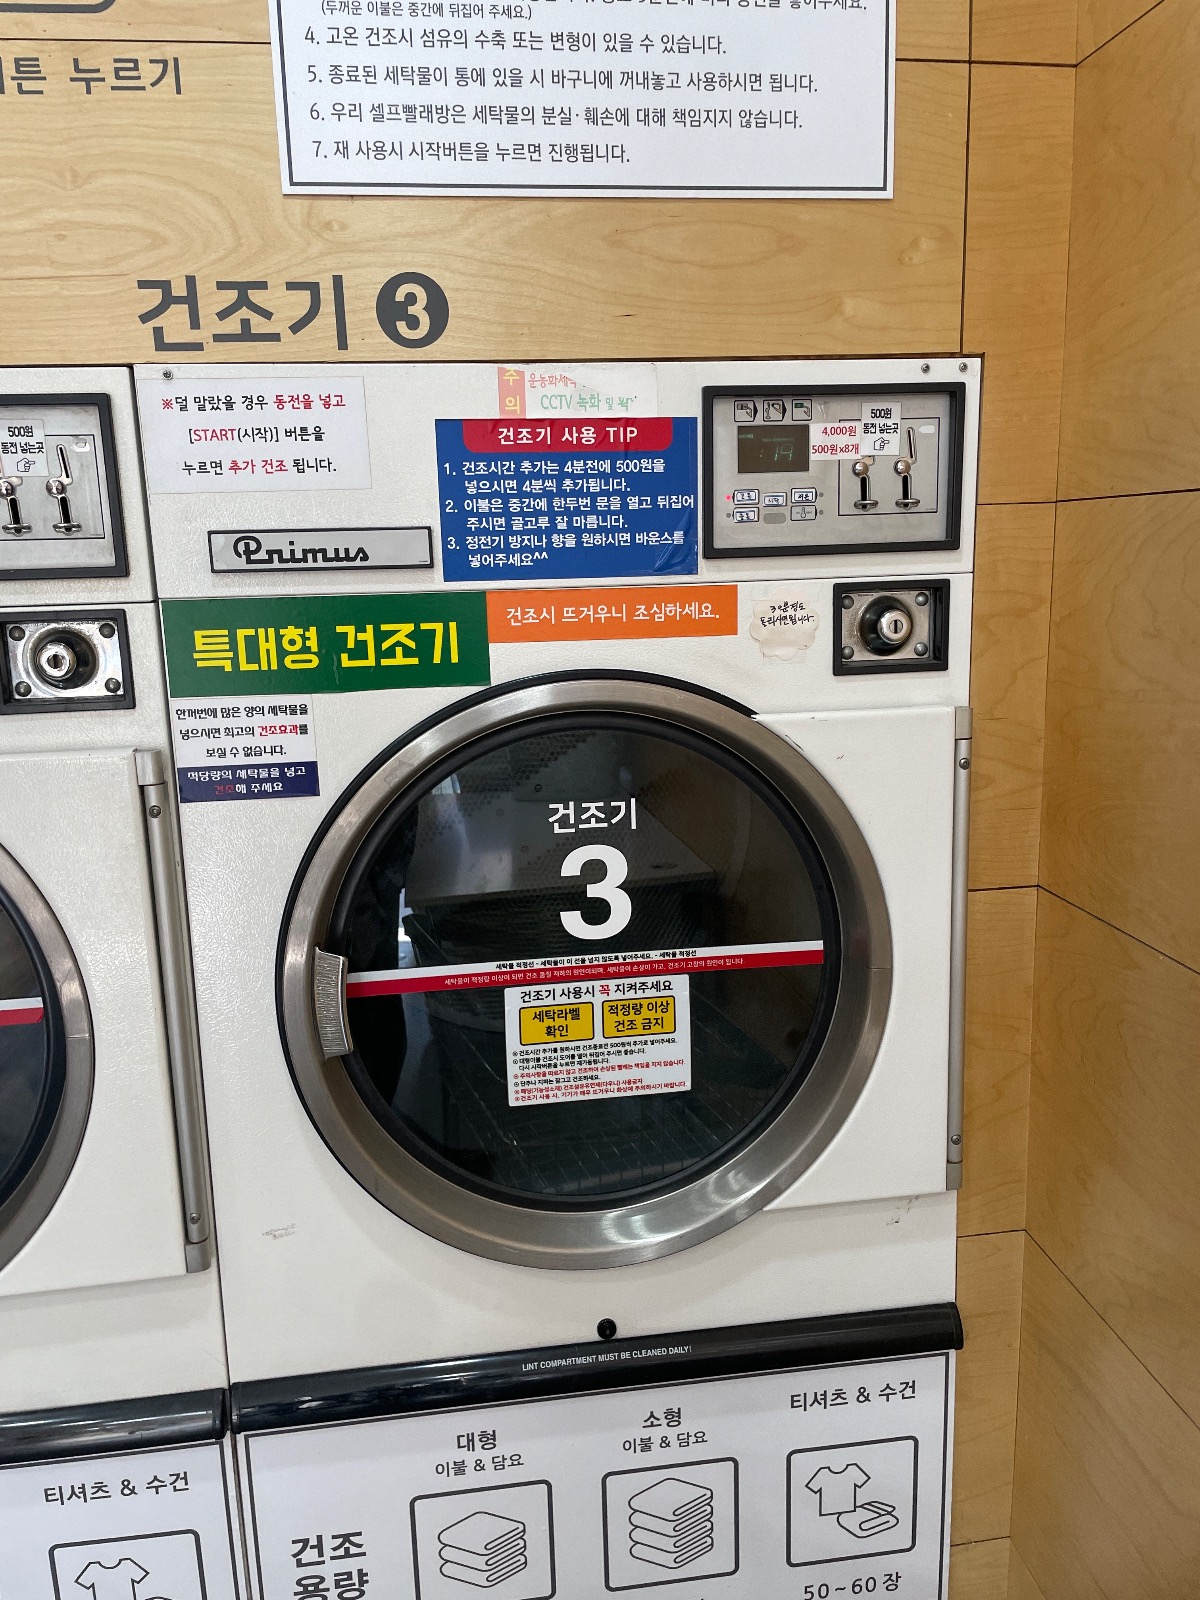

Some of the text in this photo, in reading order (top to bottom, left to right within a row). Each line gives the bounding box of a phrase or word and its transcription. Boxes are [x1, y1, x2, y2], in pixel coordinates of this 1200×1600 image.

[322, 1, 532, 20] (두꺼운 이불은 중간에 뒤집어 주세요.)
[326, 27, 726, 54] 고온 건조시 섬유의 수축 또는 변형이 있을 수 있습니다.
[70, 57, 181, 95] 누르기
[329, 64, 818, 93] 종료된 세탁물이 통에 있을 시 바구니에 꺼내놓고 사용하시면 됩니다.
[331, 103, 802, 128] 우리 셀프빨래방은 세탁물의 대해 책임지지 않습니다.
[334, 140, 630, 163] 재 사용시 시작버튼을 누르면 진행됩니다.
[136, 273, 349, 352] 건조기
[194, 396, 236, 411] 말랐을
[242, 395, 268, 410] 경우
[274, 394, 313, 410] 동전을
[319, 394, 346, 410] 넣고
[541, 394, 572, 409] CCTV
[577, 393, 601, 412] 녹화
[870, 408, 891, 419] 500원
[8, 426, 33, 437] 500원
[189, 426, 325, 443] [START(시작)] 버튼을
[498, 427, 638, 444] 건조기 사용 TIP
[822, 426, 856, 436] 4,000원
[863, 423, 899, 434] 동전 넣는곳
[1, 442, 44, 454] 동전 넣는곳
[182, 458, 336, 475] 누르면 추가 건조 됩니다.
[462, 459, 665, 475] 건조시간 추가는 4분전에 500원을
[465, 478, 630, 494] 넣으시면 4분씩 추가됩니다.
[464, 495, 694, 512] 이불은 중간에 한두번 문을 열고 뒤집어
[467, 515, 627, 531] 주시면 골고루 잘 마릅니다.
[233, 535, 369, 564] Primus
[466, 531, 684, 549] 정전기 방지나 향을 원하시면 바운스를
[507, 603, 719, 626] 건조시 뜨거우니 조심하세요.
[193, 621, 459, 672] 특대형 건조기
[176, 704, 308, 719] 한꺼번에 많은 양의 세탁물을
[224, 727, 254, 738] 최고의
[258, 724, 308, 736] 건조효과를
[206, 745, 286, 758] 보실 수 없습니다.
[188, 770, 232, 782] 적당량의
[237, 767, 279, 779] 세탁물을
[251, 782, 283, 793] 주세요
[548, 798, 636, 833] 건조기
[560, 844, 632, 940] 3
[521, 980, 673, 1003] 건조기 사용시 꼭 지켜주세요
[533, 1007, 580, 1022] 세탁라벨
[608, 1000, 670, 1016] 적정량 이상
[545, 1024, 568, 1037] 확인
[615, 1017, 664, 1032] 건조 금지
[522, 1345, 692, 1371] LINT COMPARTMENT MUST BE CLEANED DAILY!
[791, 1380, 916, 1411] 티셔츠 수건
[642, 1407, 682, 1429] 소형
[456, 1430, 498, 1452] 대형
[623, 1431, 708, 1454] 이불 담요
[435, 1453, 524, 1478] 이불 담요
[44, 1471, 189, 1505] 티셔츠 수건
[290, 1531, 367, 1568] 건조
[293, 1568, 369, 1600] 용량
[883, 1572, 902, 1592] 장
